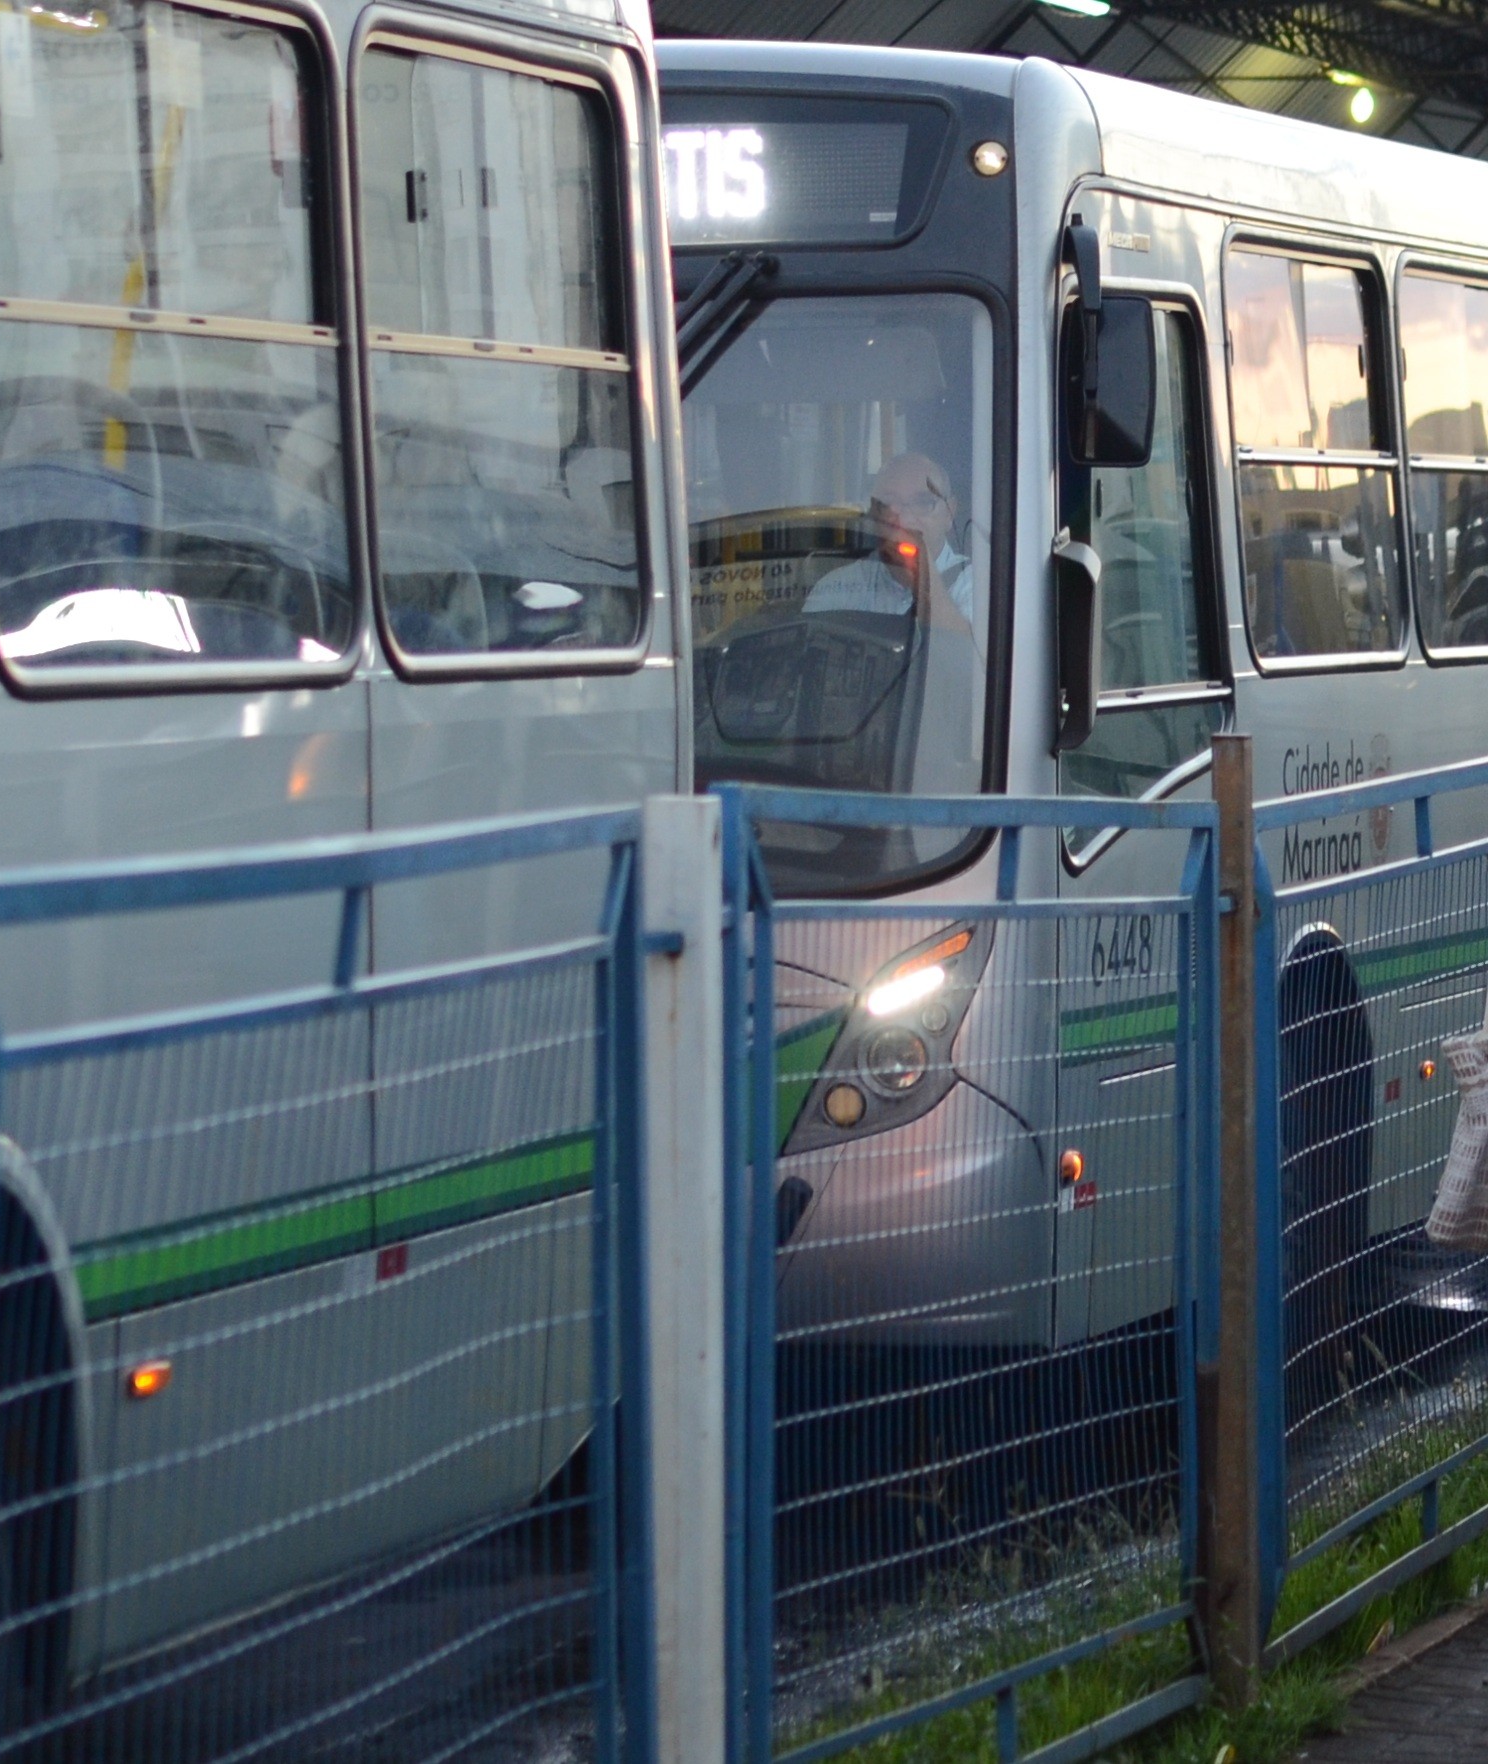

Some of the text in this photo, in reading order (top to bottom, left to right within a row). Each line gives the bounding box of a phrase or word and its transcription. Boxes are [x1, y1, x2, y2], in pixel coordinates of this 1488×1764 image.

[662, 128, 765, 220] TIS
[1282, 739, 1364, 796] Cidade de
[1281, 815, 1363, 884] Maringá
[1091, 913, 1151, 987] 6448
